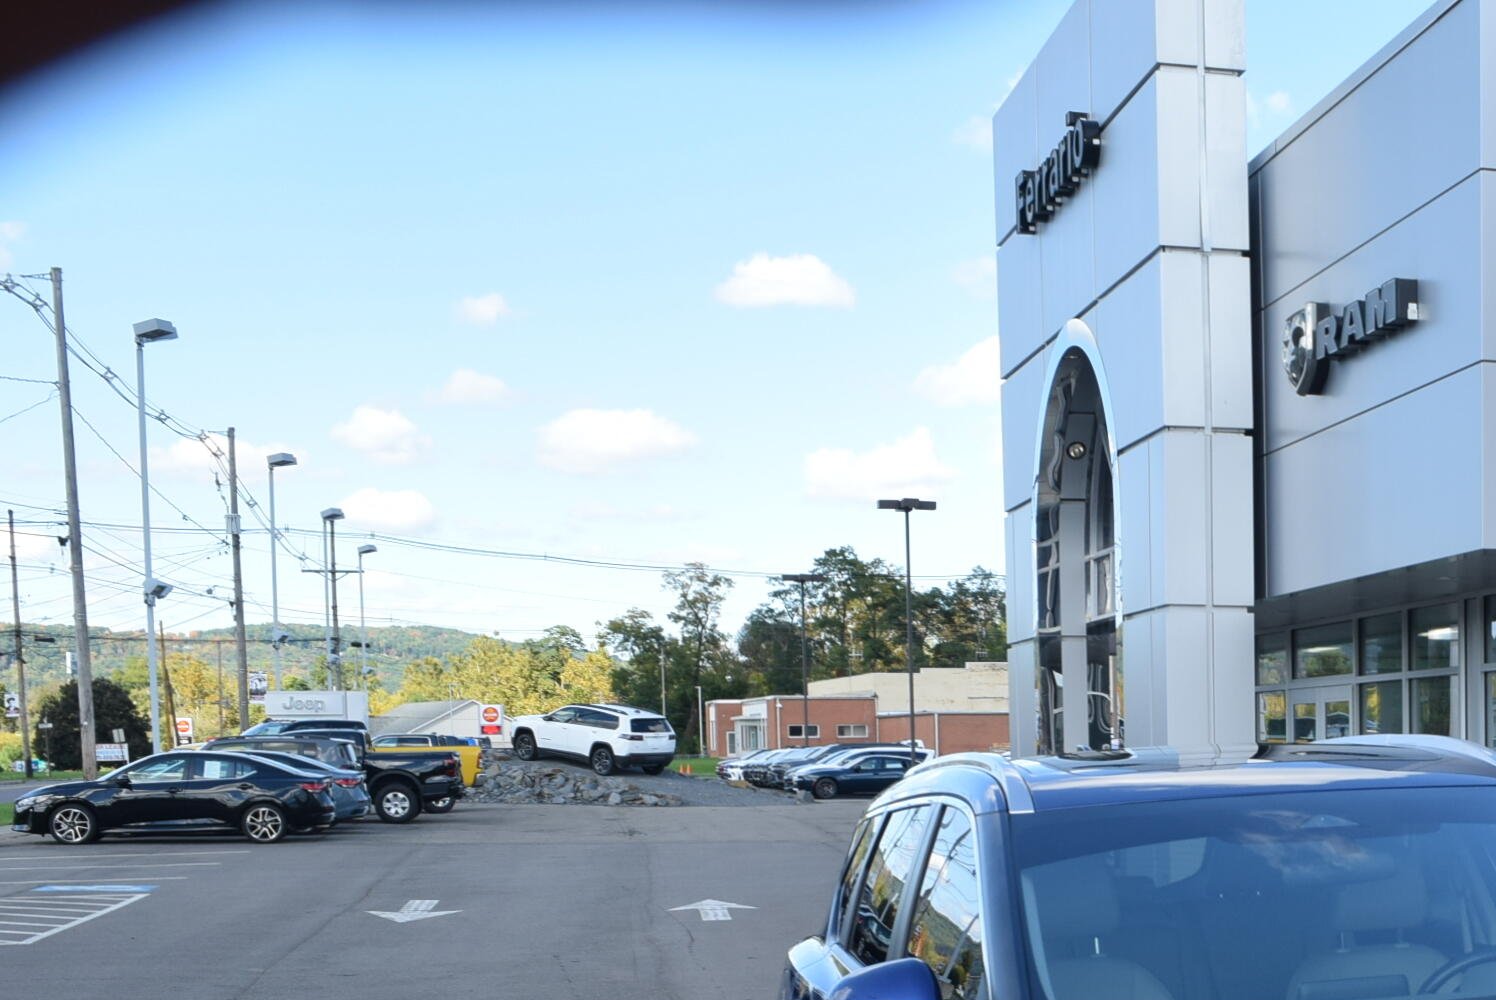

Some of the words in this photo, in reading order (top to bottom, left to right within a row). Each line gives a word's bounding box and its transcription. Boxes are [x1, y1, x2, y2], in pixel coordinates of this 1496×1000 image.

[1015, 111, 1094, 234] Ferrario
[1316, 278, 1404, 360] RAM
[282, 696, 325, 713] Jeep
